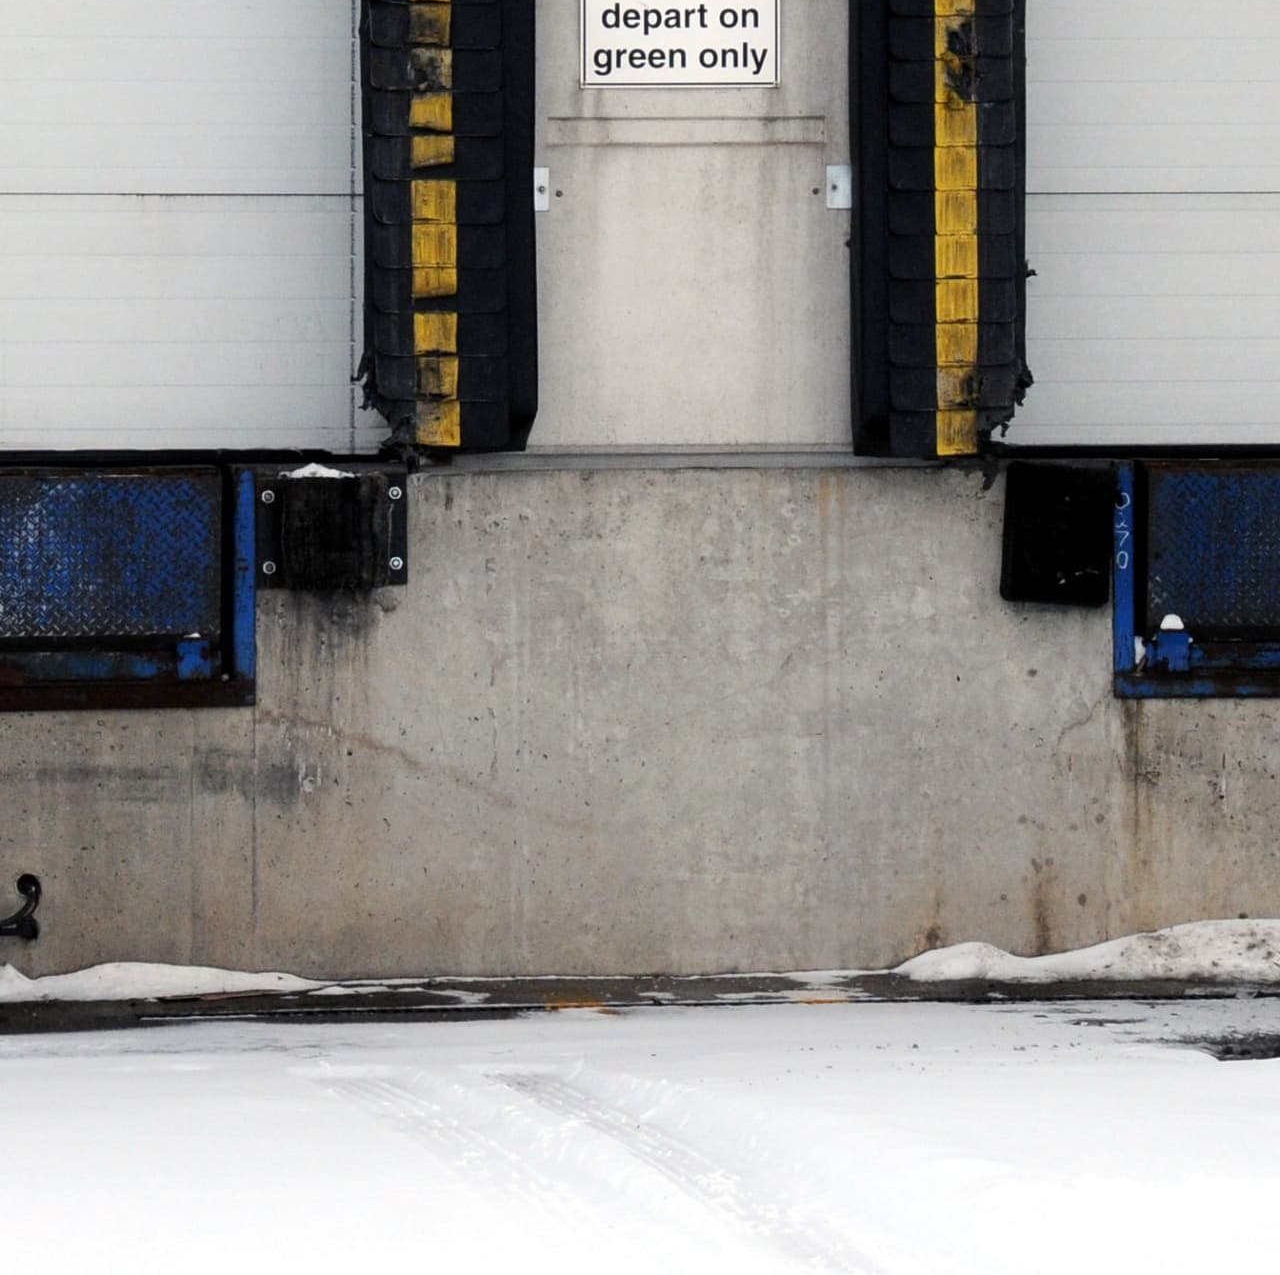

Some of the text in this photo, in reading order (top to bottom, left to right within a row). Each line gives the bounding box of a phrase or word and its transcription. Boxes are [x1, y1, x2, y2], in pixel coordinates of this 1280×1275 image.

[601, 2, 759, 36] depart on
[593, 41, 768, 76] green only
